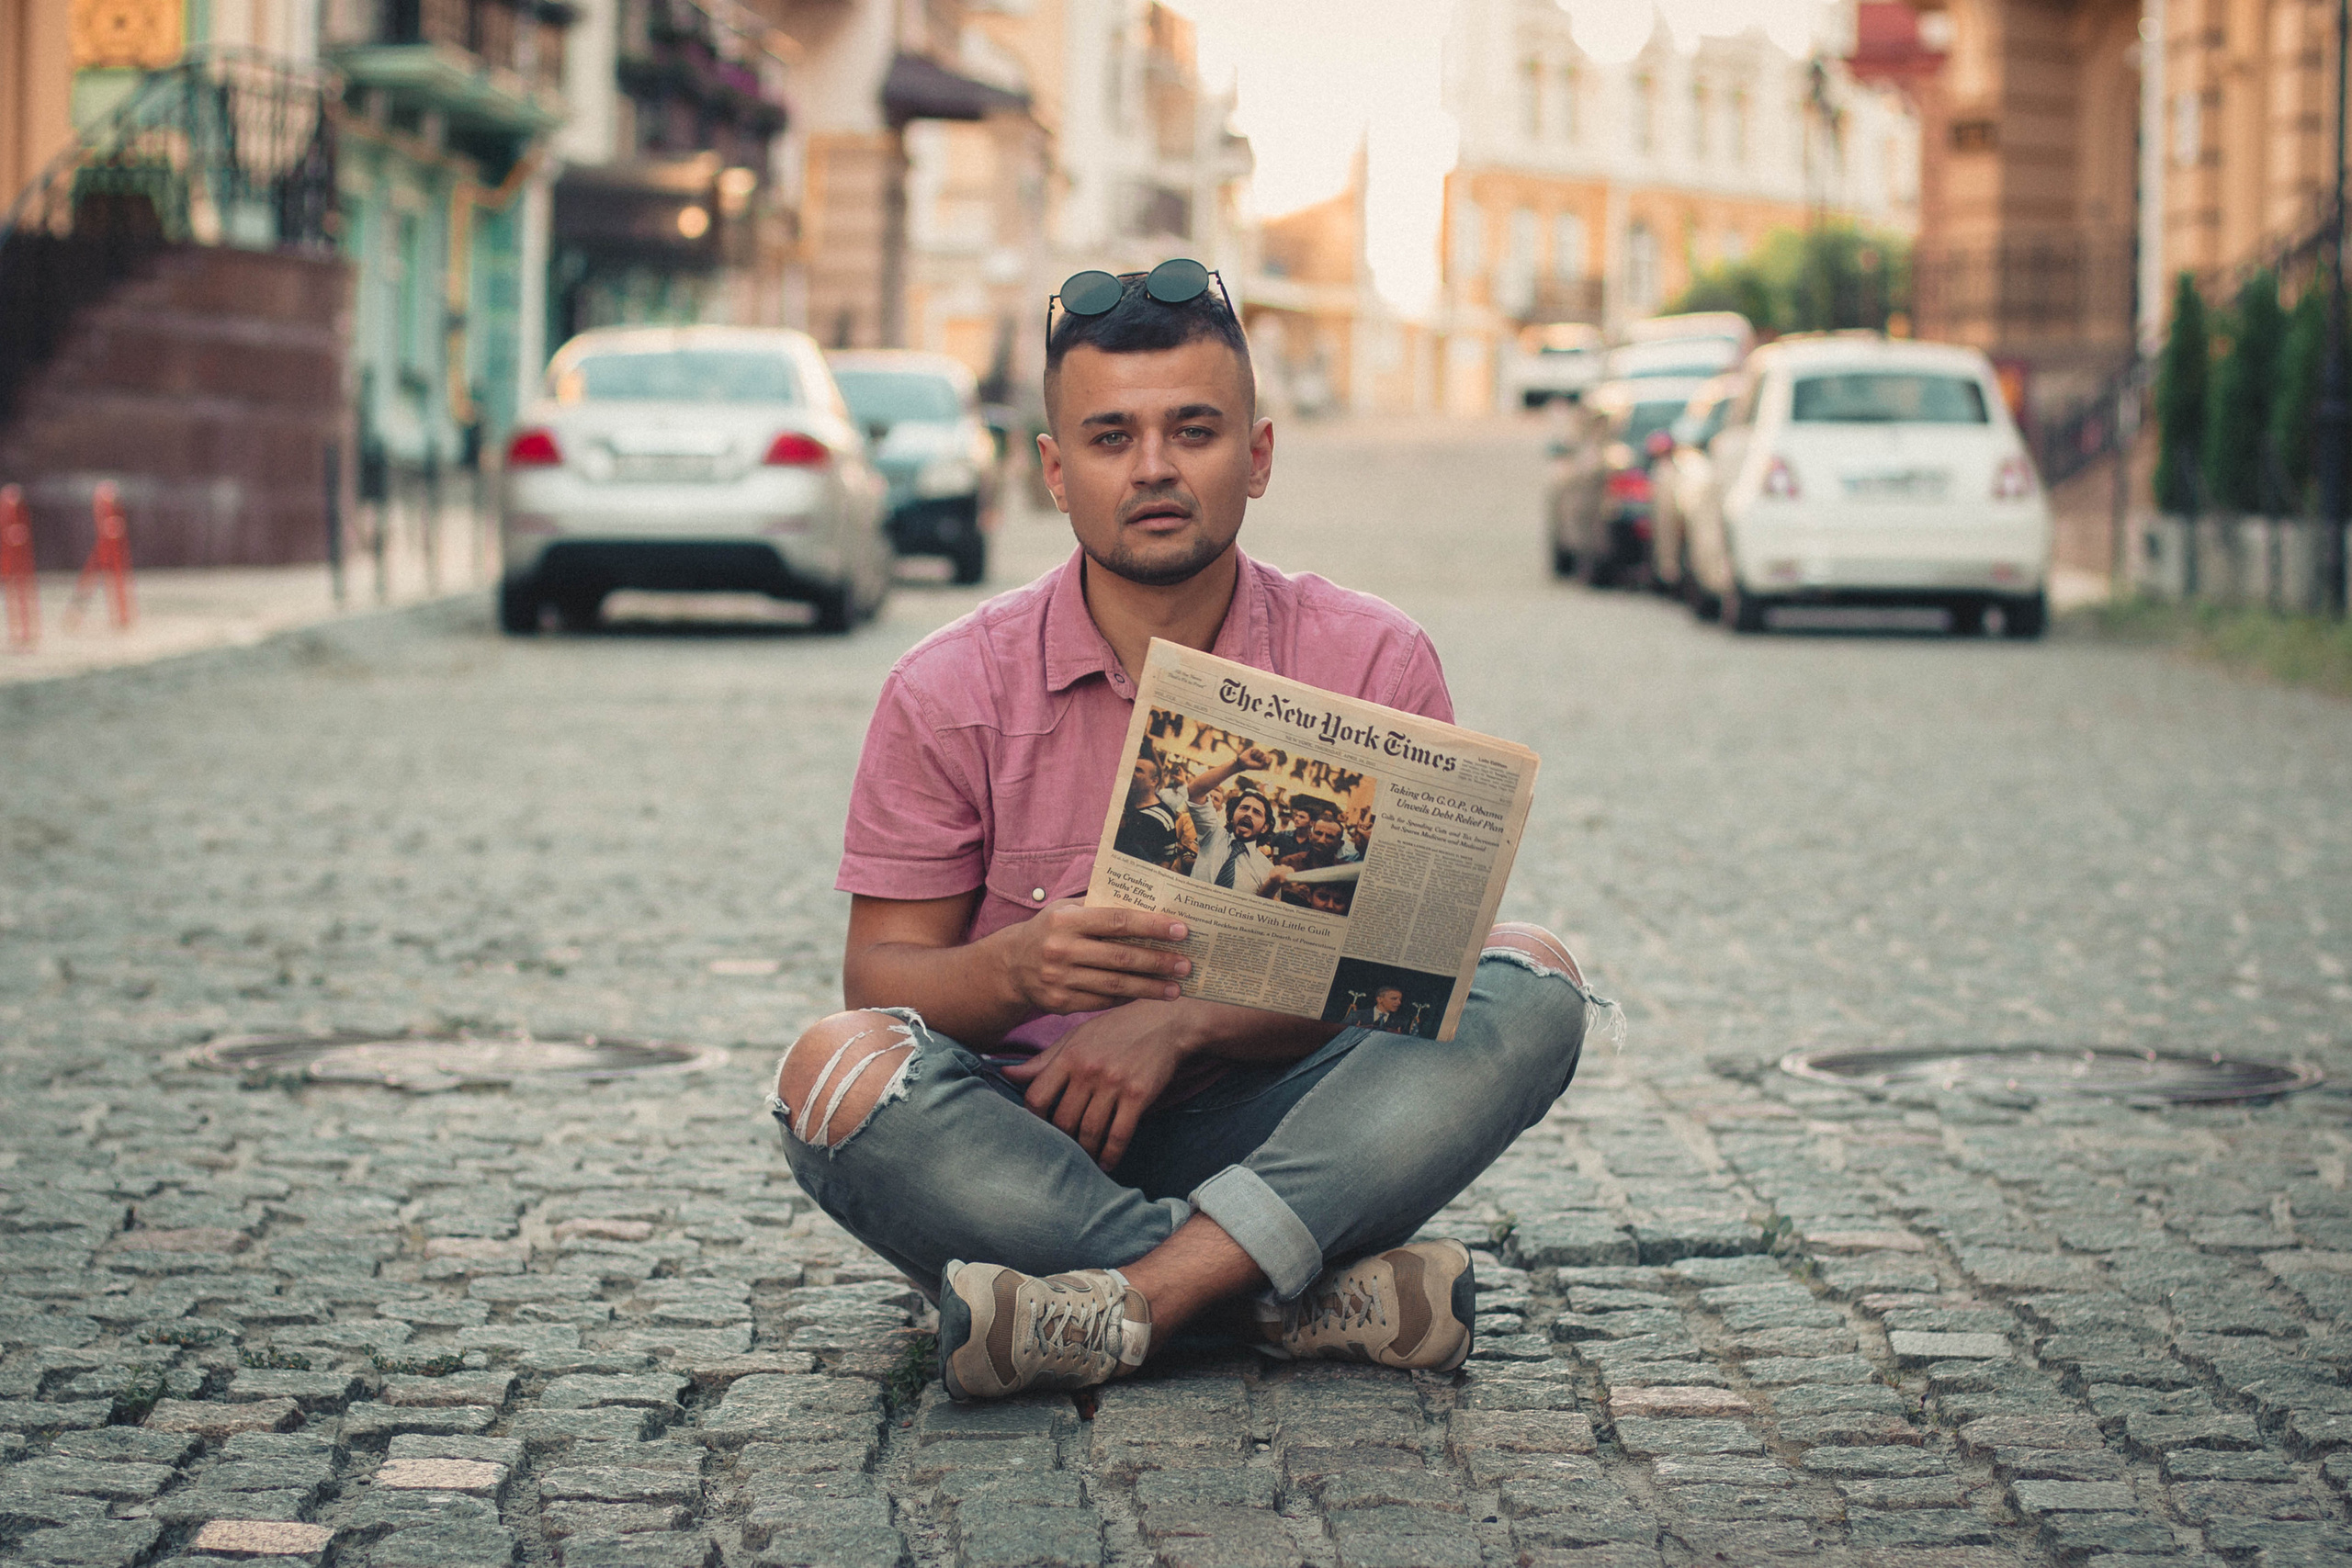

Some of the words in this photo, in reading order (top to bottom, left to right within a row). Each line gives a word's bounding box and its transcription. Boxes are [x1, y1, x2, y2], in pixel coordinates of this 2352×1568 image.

[1219, 678, 1262, 712] The
[1264, 694, 1317, 729] New
[1318, 712, 1380, 750] York
[1384, 730, 1456, 772] Times
[1389, 783, 1419, 800] Taking
[1421, 792, 1434, 803] On
[1436, 795, 1467, 812] G.O.P.,
[1470, 805, 1503, 820] Obama
[1396, 798, 1430, 814] Unveils
[1431, 807, 1454, 820] Debt
[1455, 814, 1484, 828] Relief
[1483, 820, 1504, 834] Plan
[1381, 813, 1395, 821] Calls
[1407, 819, 1432, 832] Spending
[1474, 837, 1499, 847] Increases
[1421, 830, 1447, 842] Medicare
[1460, 840, 1487, 852] Medicaid
[1106, 867, 1121, 879] Iraq
[1123, 873, 1153, 890] Crushing
[1107, 877, 1133, 892] Youths'
[1132, 887, 1156, 901] Efforts
[1113, 889, 1121, 898] To
[1122, 894, 1132, 903] Be
[1133, 897, 1156, 912] Heard
[1174, 893, 1182, 903] A
[1184, 896, 1227, 915] Financial
[1228, 908, 1254, 920] Crisis
[1257, 914, 1279, 927] With
[1282, 919, 1305, 932] Little
[1307, 925, 1331, 937] Guilt
[1161, 907, 1176, 916] After
[1178, 910, 1212, 926] Widespread
[1213, 920, 1238, 931] Reckless
[1239, 926, 1265, 937] Banking,
[1271, 932, 1291, 942] Dearth
[1299, 938, 1337, 951] Prosecutions
